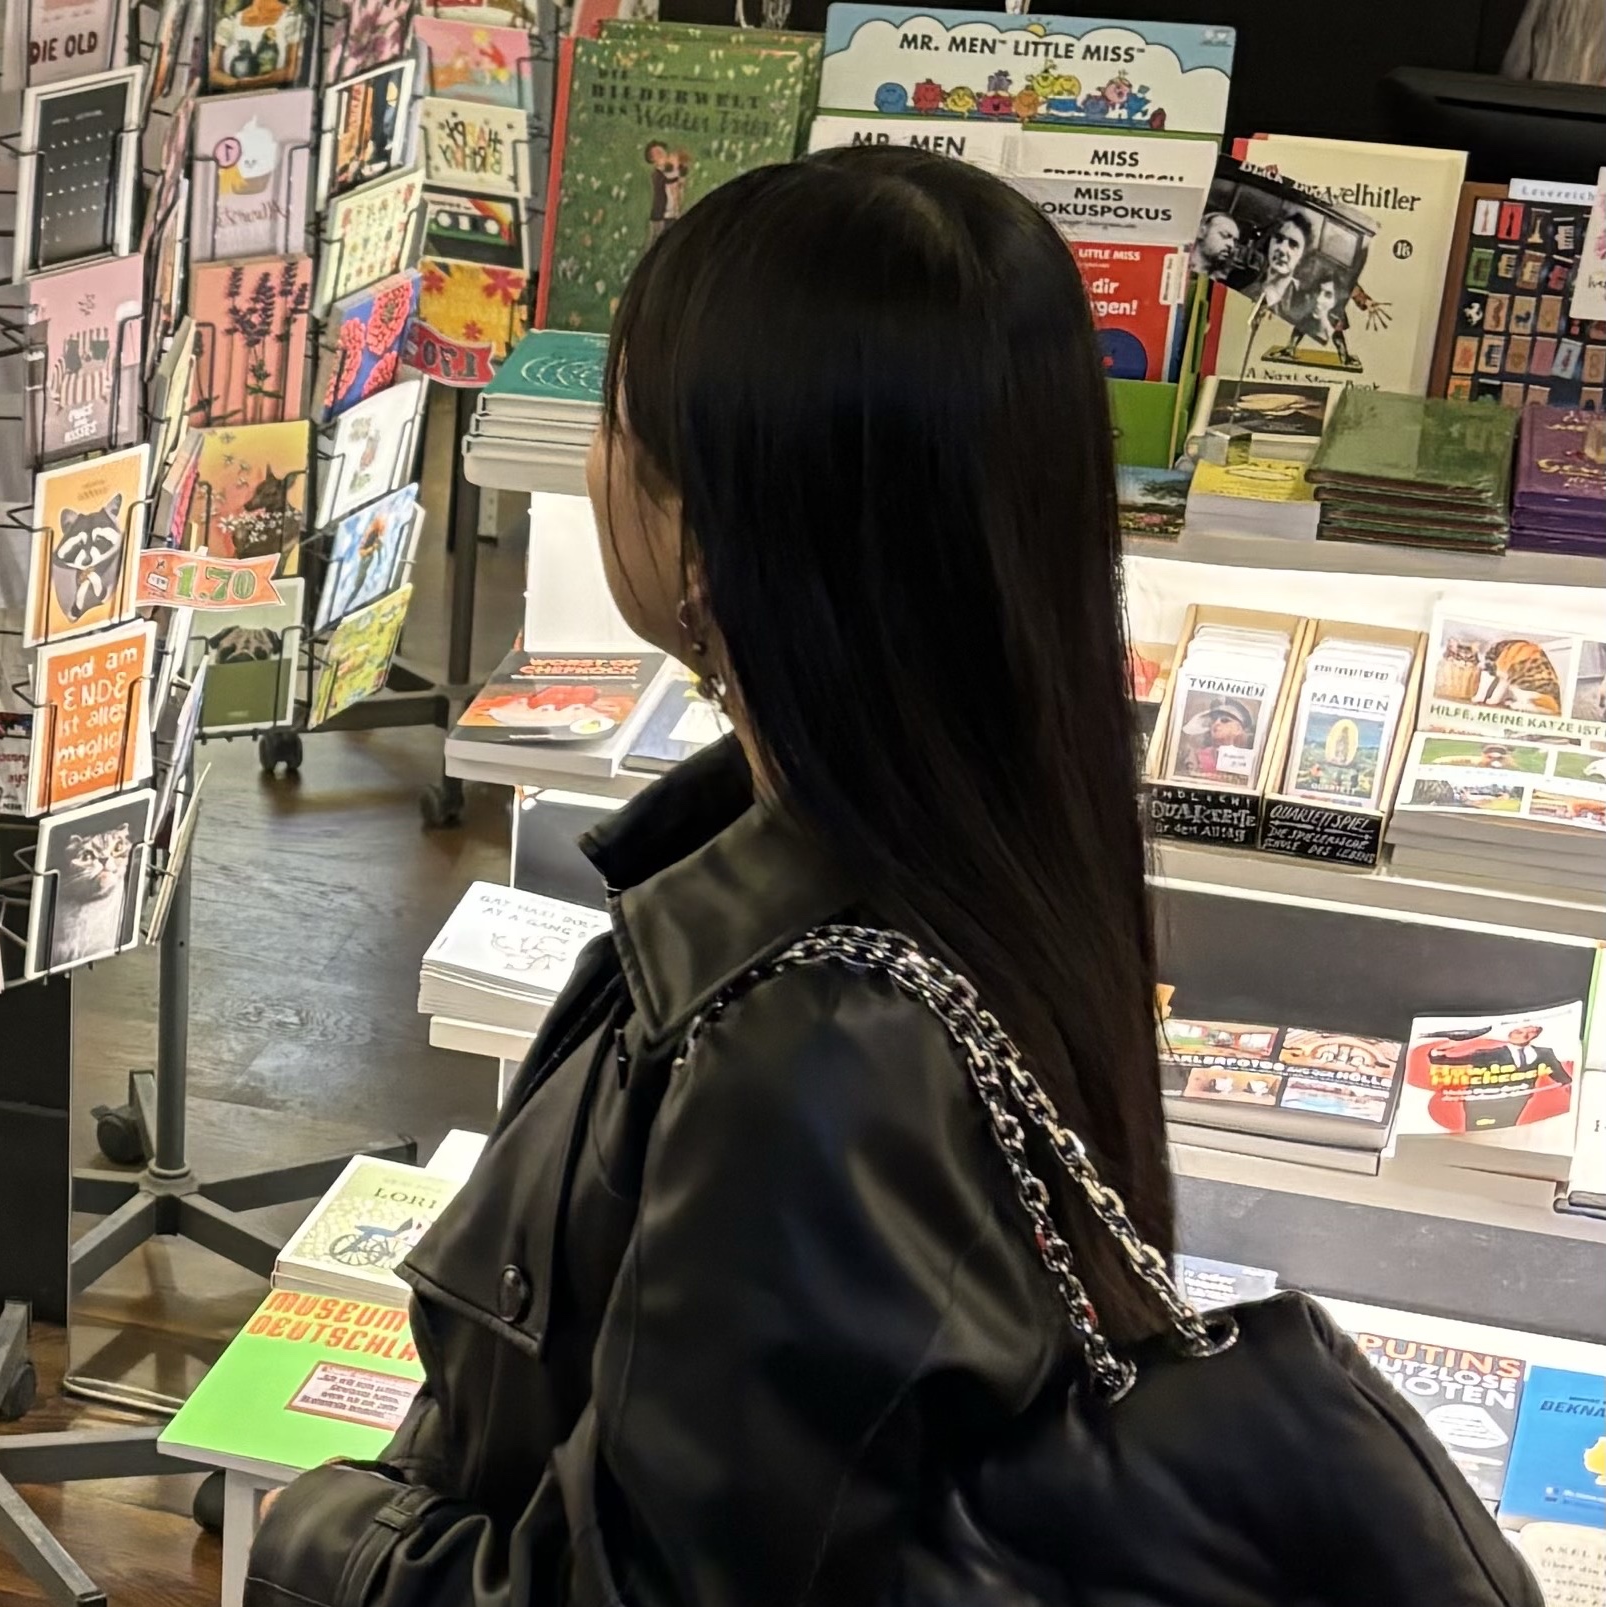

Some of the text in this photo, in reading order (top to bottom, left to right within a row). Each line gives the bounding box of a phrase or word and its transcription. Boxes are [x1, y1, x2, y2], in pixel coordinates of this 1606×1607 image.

[899, 33, 940, 52] MR.
[1013, 39, 1075, 59] LITTLE
[851, 131, 965, 157] MR MEN
[1090, 150, 1139, 167] MISS
[1074, 186, 1124, 202] MISS
[174, 563, 258, 602] 1.70
[57, 647, 138, 685] und am
[62, 671, 127, 712] ENDE
[1429, 703, 1602, 737] HILFE, MEINE KATZE IST
[265, 1290, 409, 1333] MUSEUM
[246, 1313, 417, 1362] DEUTSCHLA
[1357, 1332, 1522, 1378] PUTINS
[1394, 1372, 1517, 1410] IOTEN
